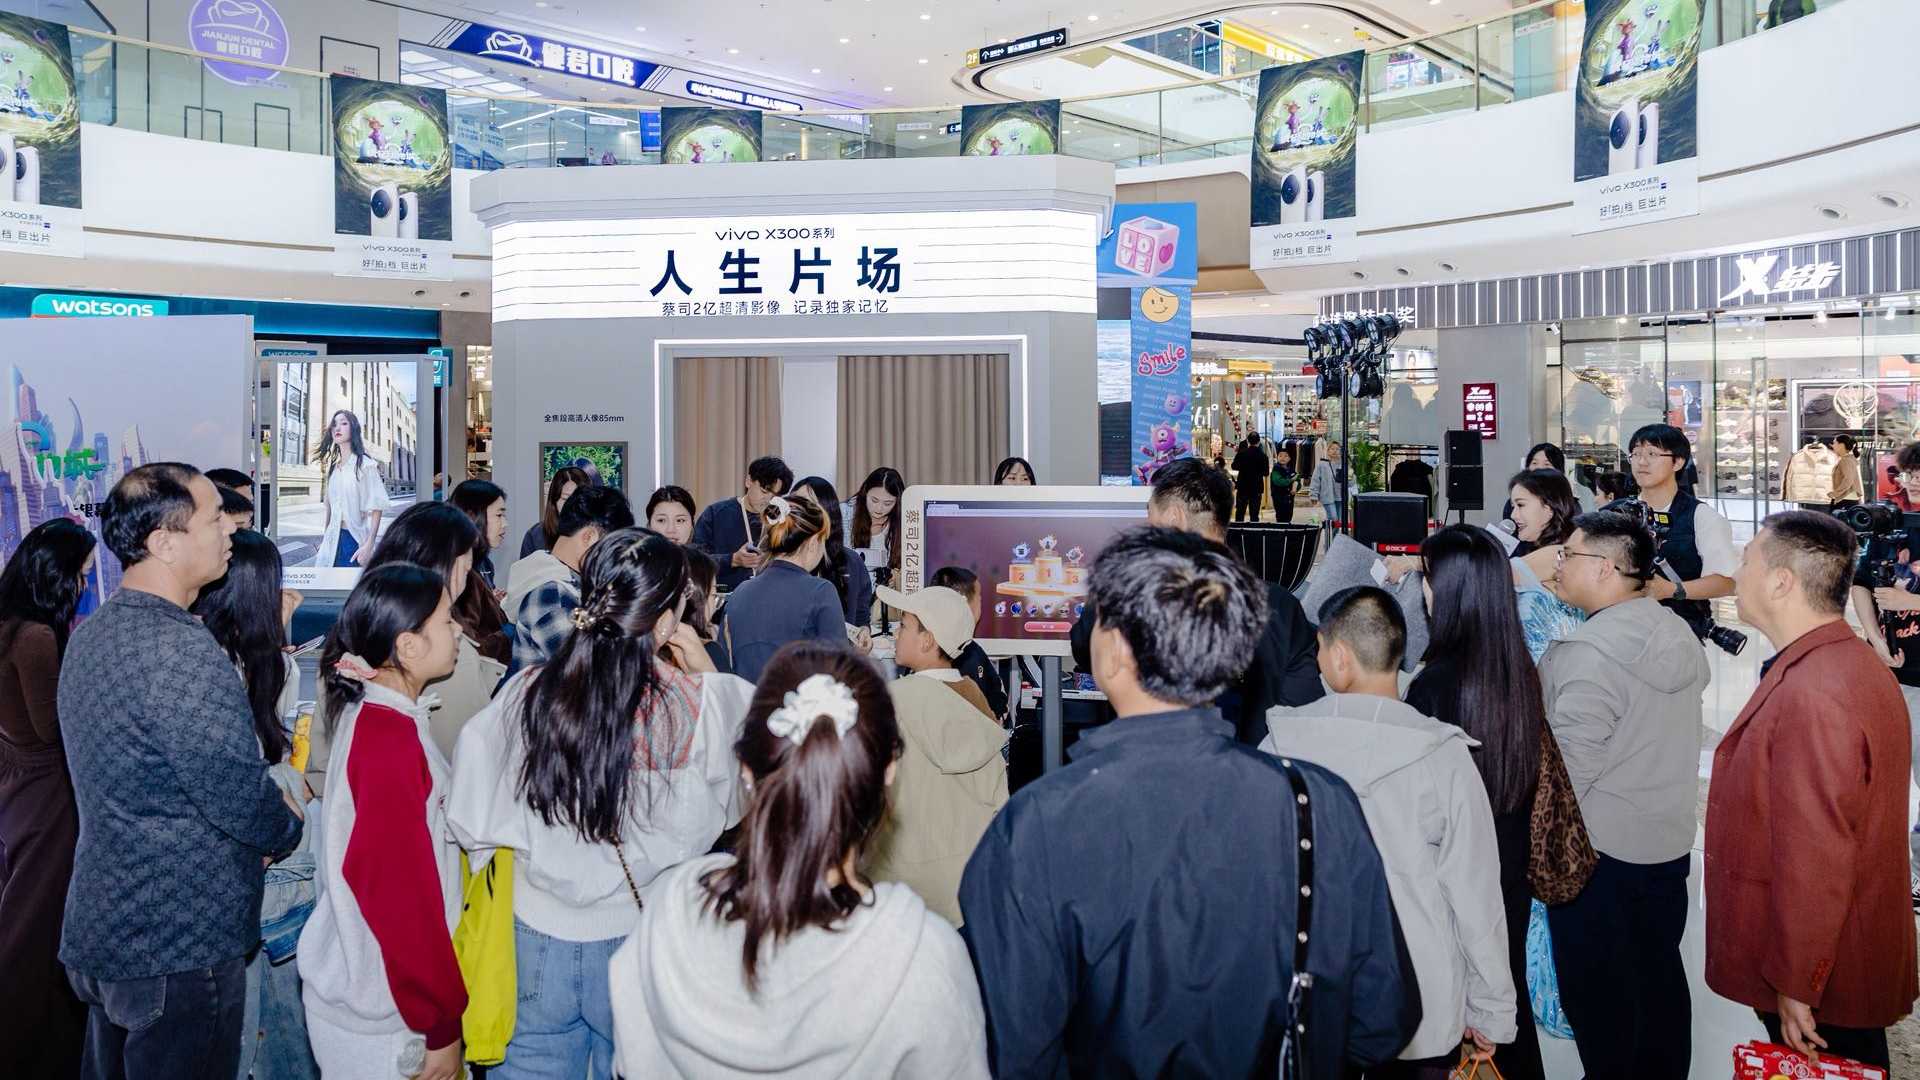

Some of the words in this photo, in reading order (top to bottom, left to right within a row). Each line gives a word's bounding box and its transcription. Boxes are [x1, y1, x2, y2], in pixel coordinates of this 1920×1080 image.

[201, 30, 240, 42] JIANJUN
[242, 36, 276, 50] DENTAL
[967, 52, 978, 64] 2F
[1600, 184, 1621, 194] vivo
[1638, 196, 1667, 210] 巨出片
[18, 230, 50, 242] 巨出片
[715, 228, 760, 241] vivo
[765, 228, 835, 240] X300系列
[362, 244, 385, 252] vivo
[401, 261, 427, 270] 巨出片
[650, 246, 900, 297] 人生片场
[52, 300, 154, 316] watsons
[662, 301, 780, 316] 蔡司2亿超清影像
[793, 299, 889, 314] 记录独家记忆
[1138, 342, 1186, 375] Smile
[544, 414, 624, 422] 全焦段高清人像85mm
